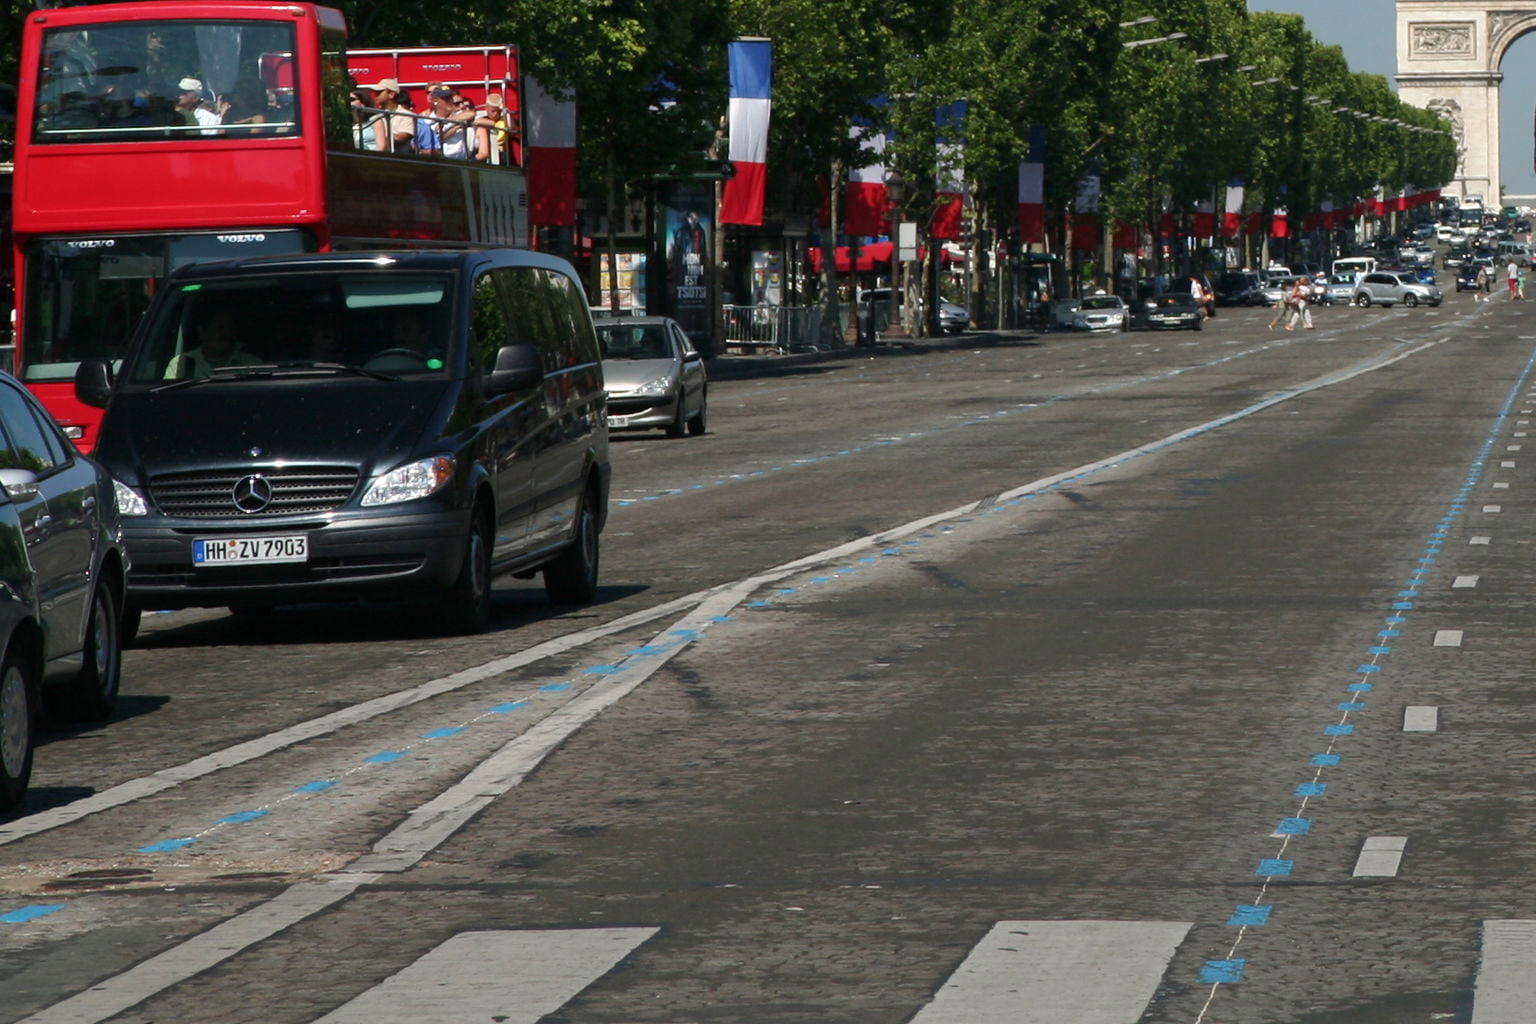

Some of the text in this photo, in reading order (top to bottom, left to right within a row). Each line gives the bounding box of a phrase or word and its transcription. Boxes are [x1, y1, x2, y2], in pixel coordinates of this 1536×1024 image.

[217, 233, 266, 243] VOLVO
[68, 239, 116, 249] VOLVO
[206, 542, 227, 560] HH
[239, 540, 260, 558] ZV
[264, 538, 305, 557] 7903
